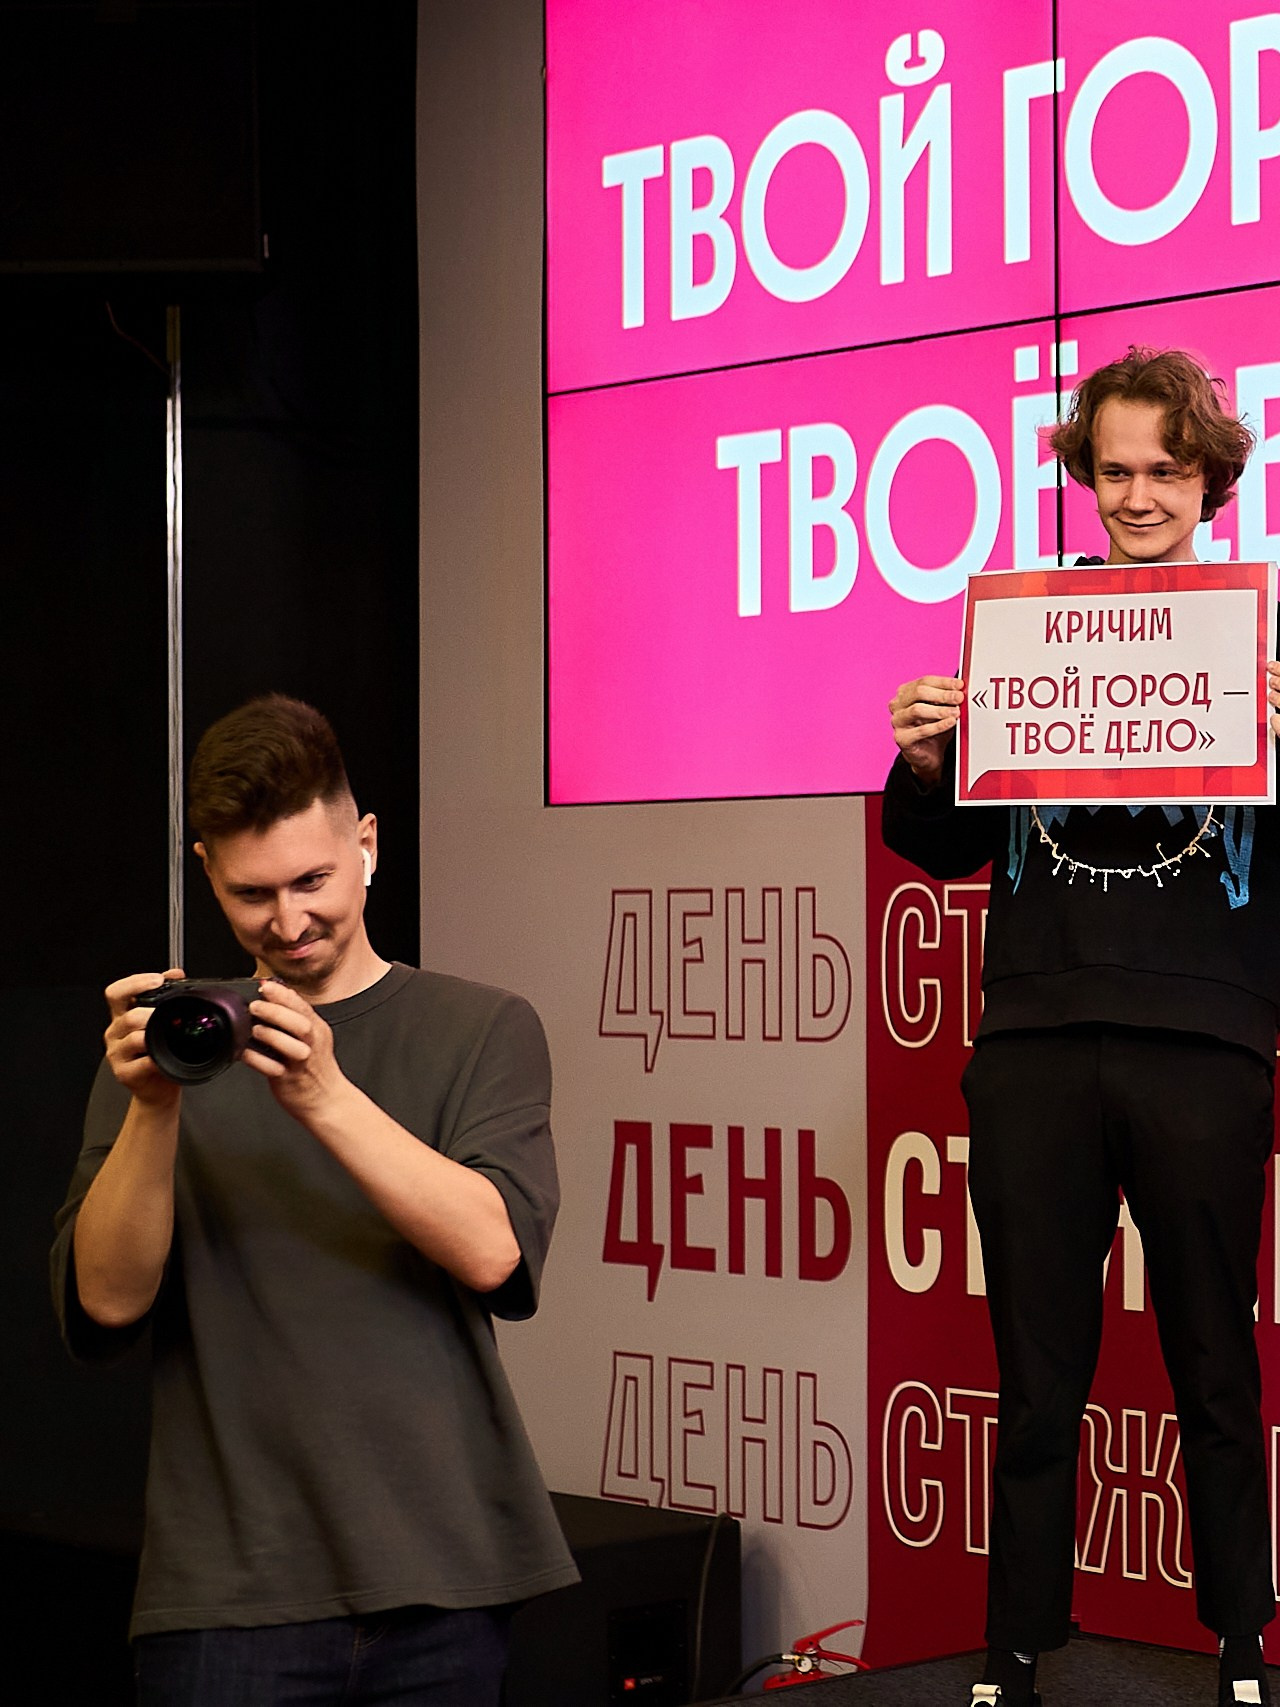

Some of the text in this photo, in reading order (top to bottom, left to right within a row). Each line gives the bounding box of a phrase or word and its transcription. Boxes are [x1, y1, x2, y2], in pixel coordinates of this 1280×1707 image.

[602, 28, 952, 329] ТВОЙ
[971, 665, 1081, 710] «ТВОЙ
[1091, 671, 1213, 713] ГОРОД
[1044, 606, 1173, 644] КРИЧИМ
[1005, 713, 1217, 761] ТВОЁ ДЕЛО»
[599, 886, 852, 1074] ДЕНЬ
[602, 1119, 852, 1303] ДЕНЬ
[601, 1350, 853, 1530] ДЕНЬ
